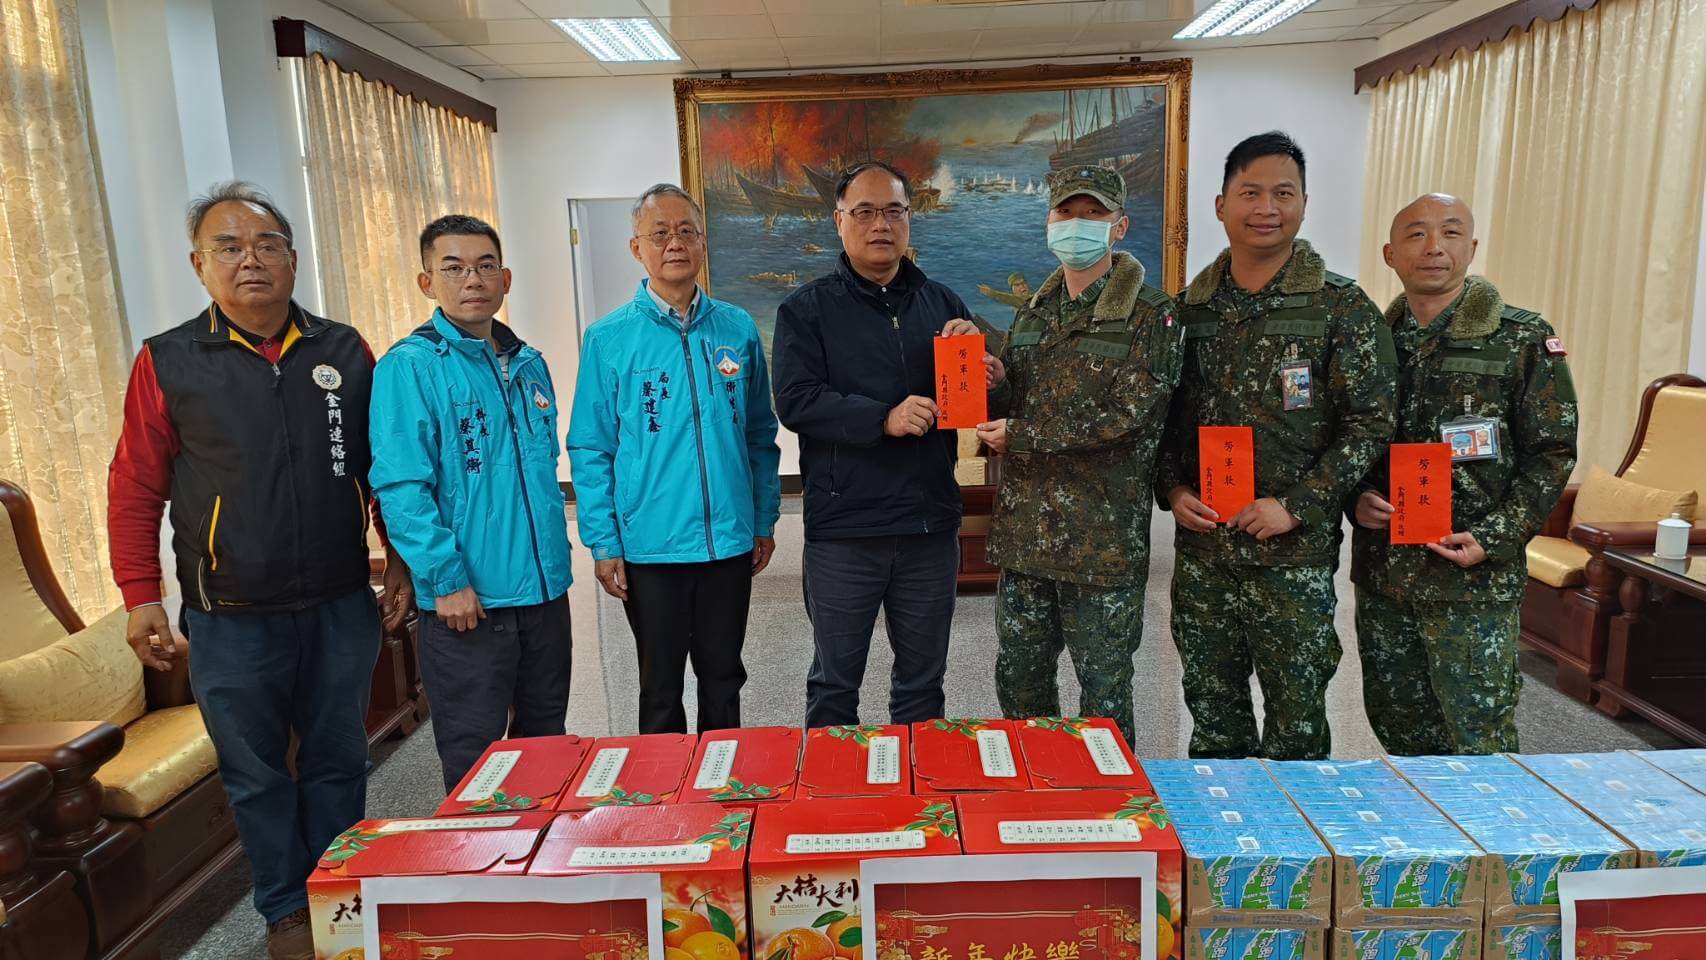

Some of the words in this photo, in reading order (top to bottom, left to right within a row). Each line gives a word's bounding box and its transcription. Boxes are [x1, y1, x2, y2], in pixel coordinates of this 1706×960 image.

[658, 371, 672, 400] 局長
[324, 392, 347, 477] 金門連絡組
[1223, 440, 1236, 487] 勞軍款
[1418, 458, 1431, 506] 勞軍款
[773, 873, 859, 908] 大桔大利
